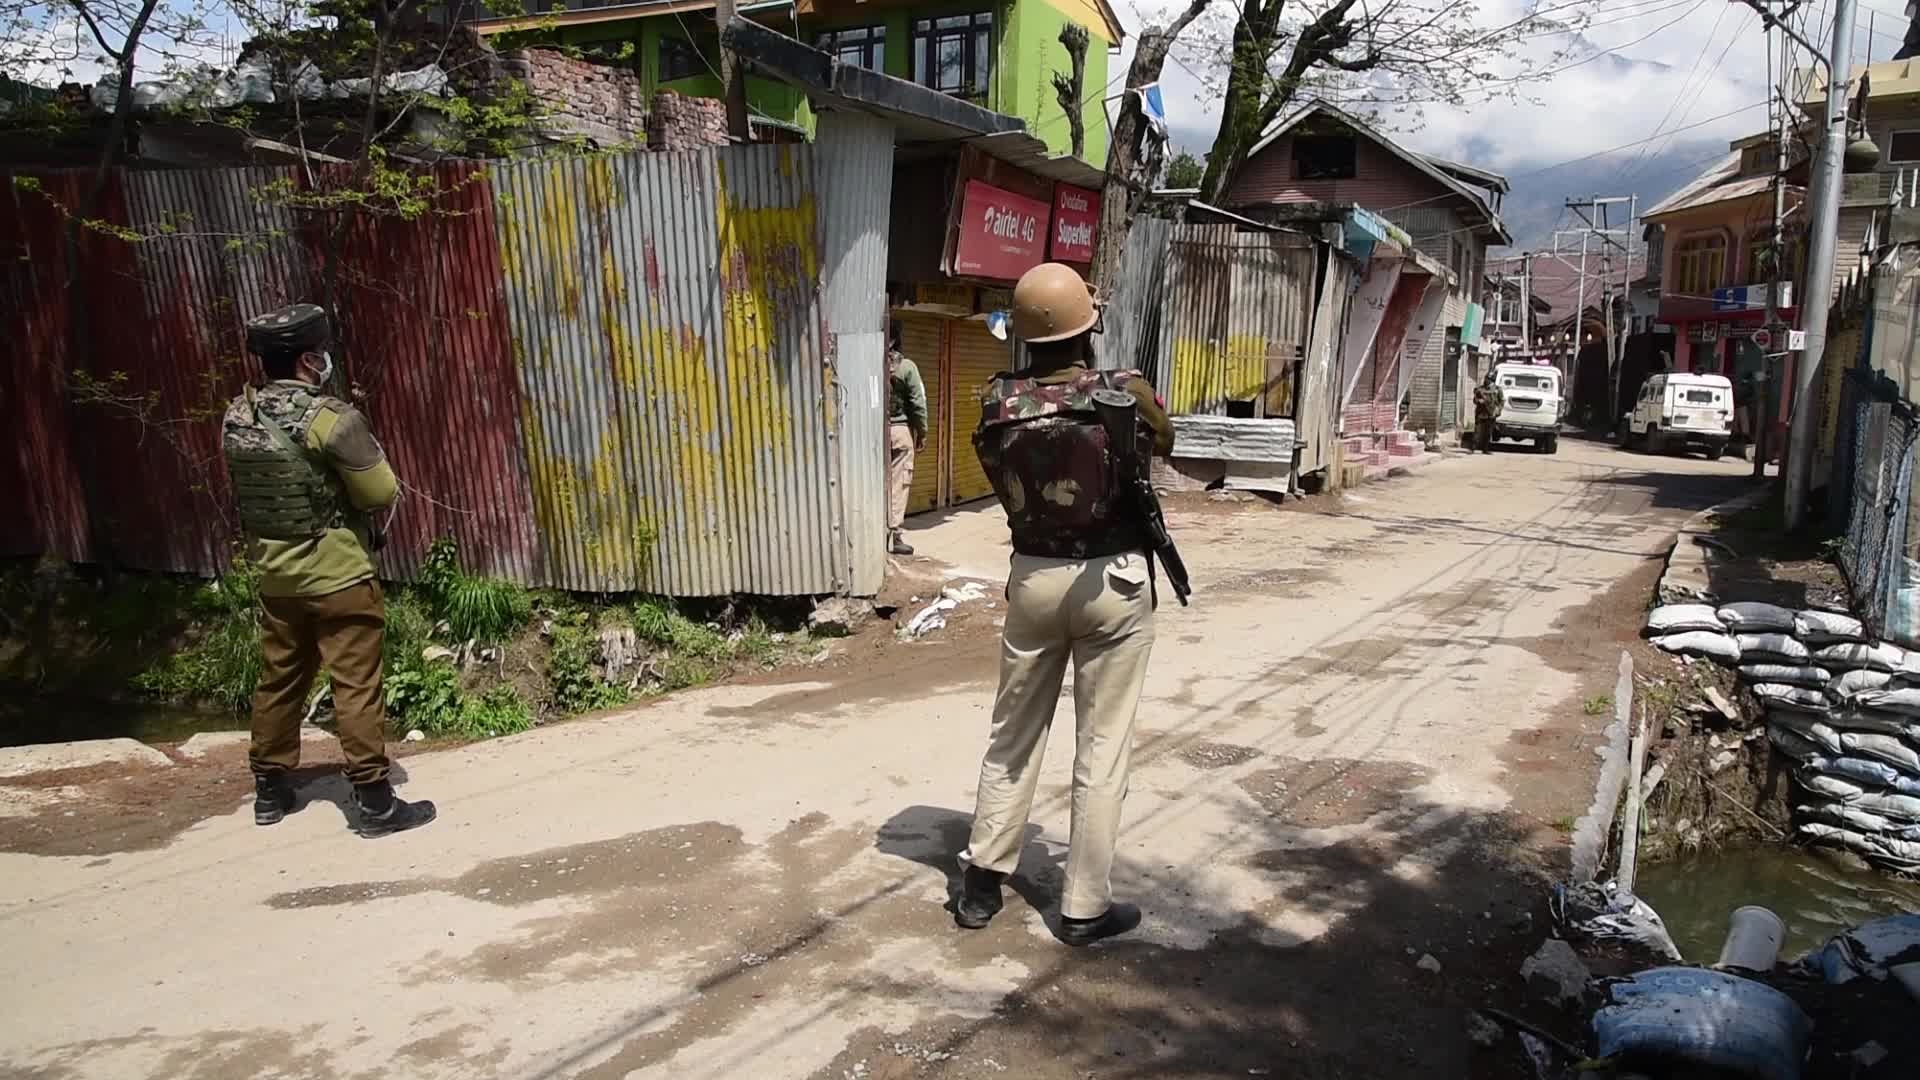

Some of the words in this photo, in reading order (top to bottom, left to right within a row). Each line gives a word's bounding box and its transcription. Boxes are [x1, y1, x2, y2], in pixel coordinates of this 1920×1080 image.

[993, 205, 1020, 239] airtel
[1021, 215, 1036, 243] 4G
[1058, 217, 1091, 249] SuperNet
